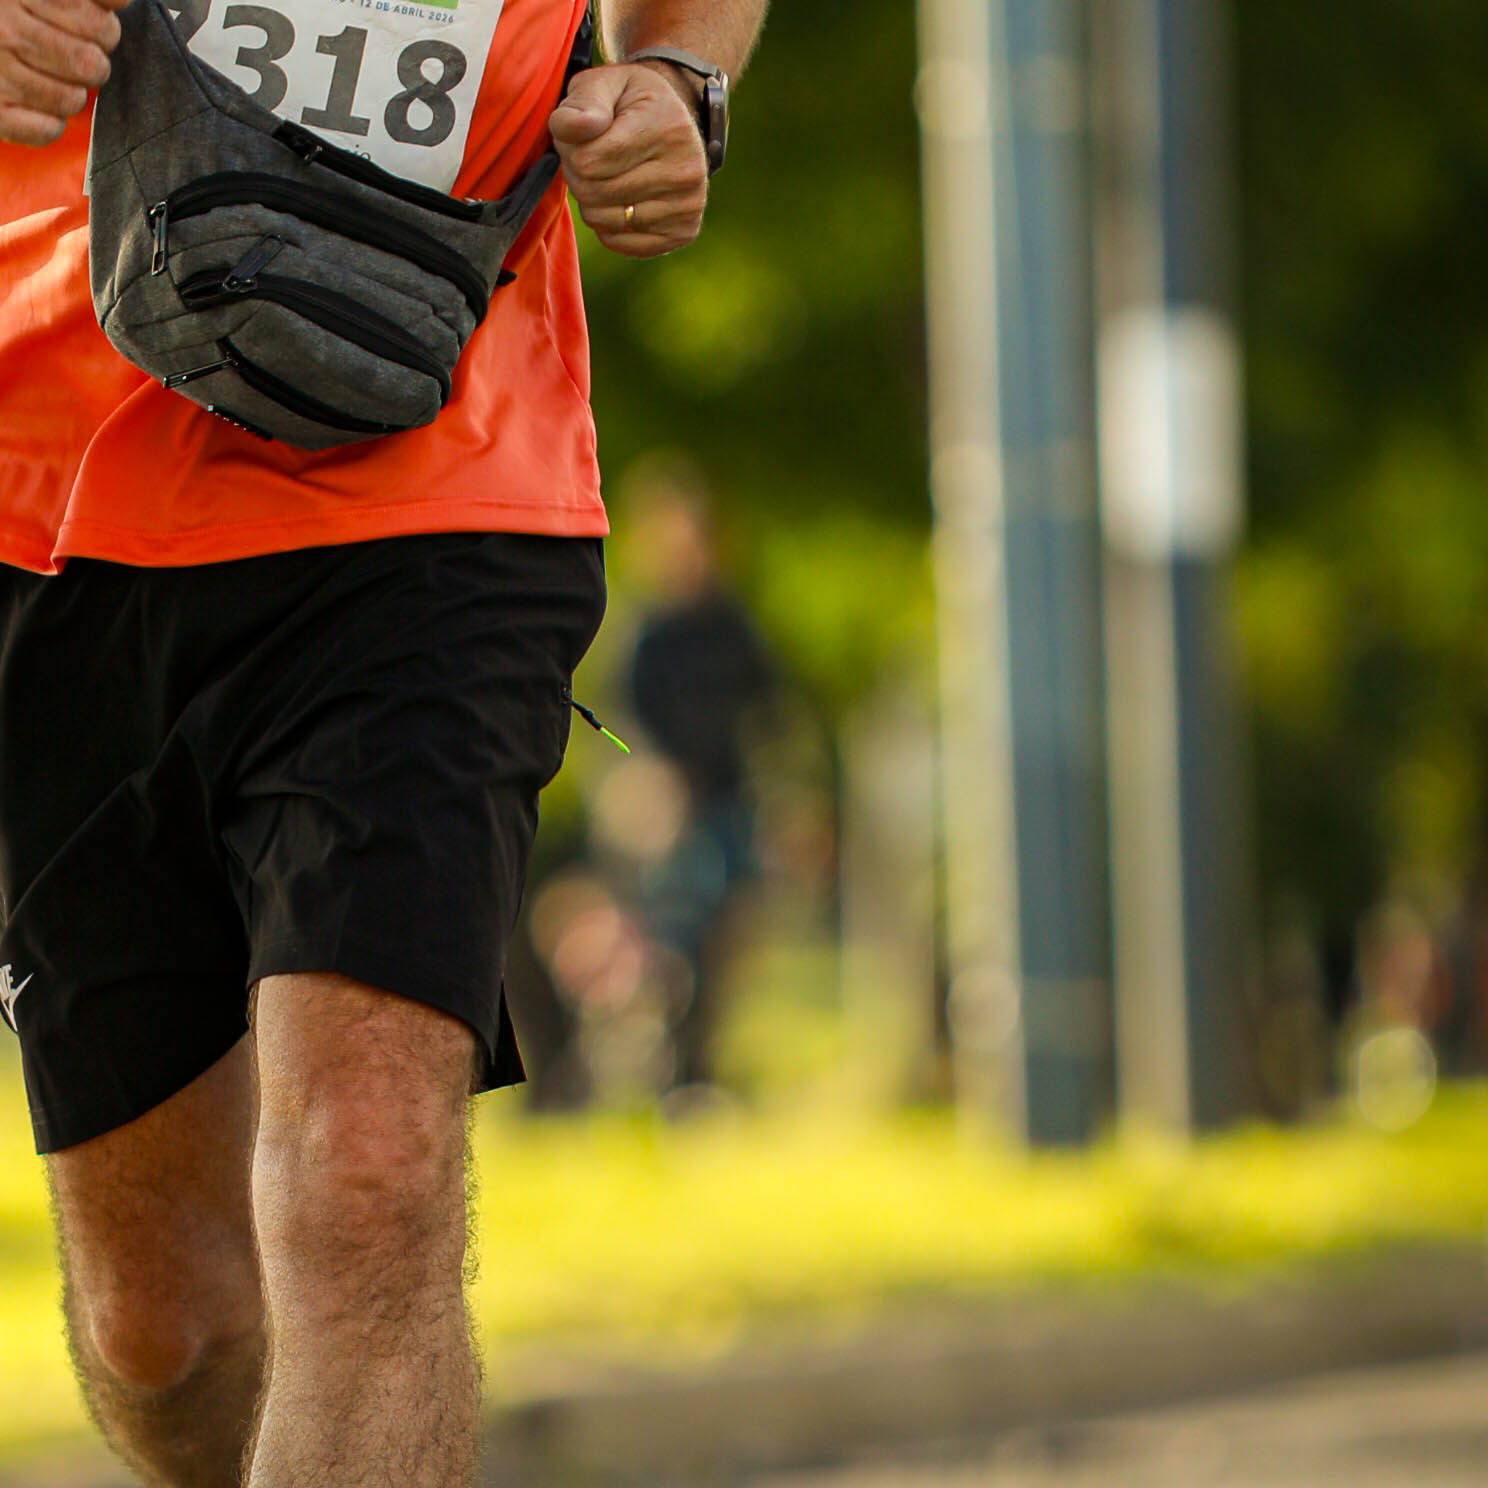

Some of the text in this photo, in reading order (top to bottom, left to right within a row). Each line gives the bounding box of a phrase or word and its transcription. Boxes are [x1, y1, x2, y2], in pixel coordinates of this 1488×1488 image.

[375, 2, 390, 12] DE
[393, 5, 425, 18] ABRIL
[427, 12, 455, 24] 2026
